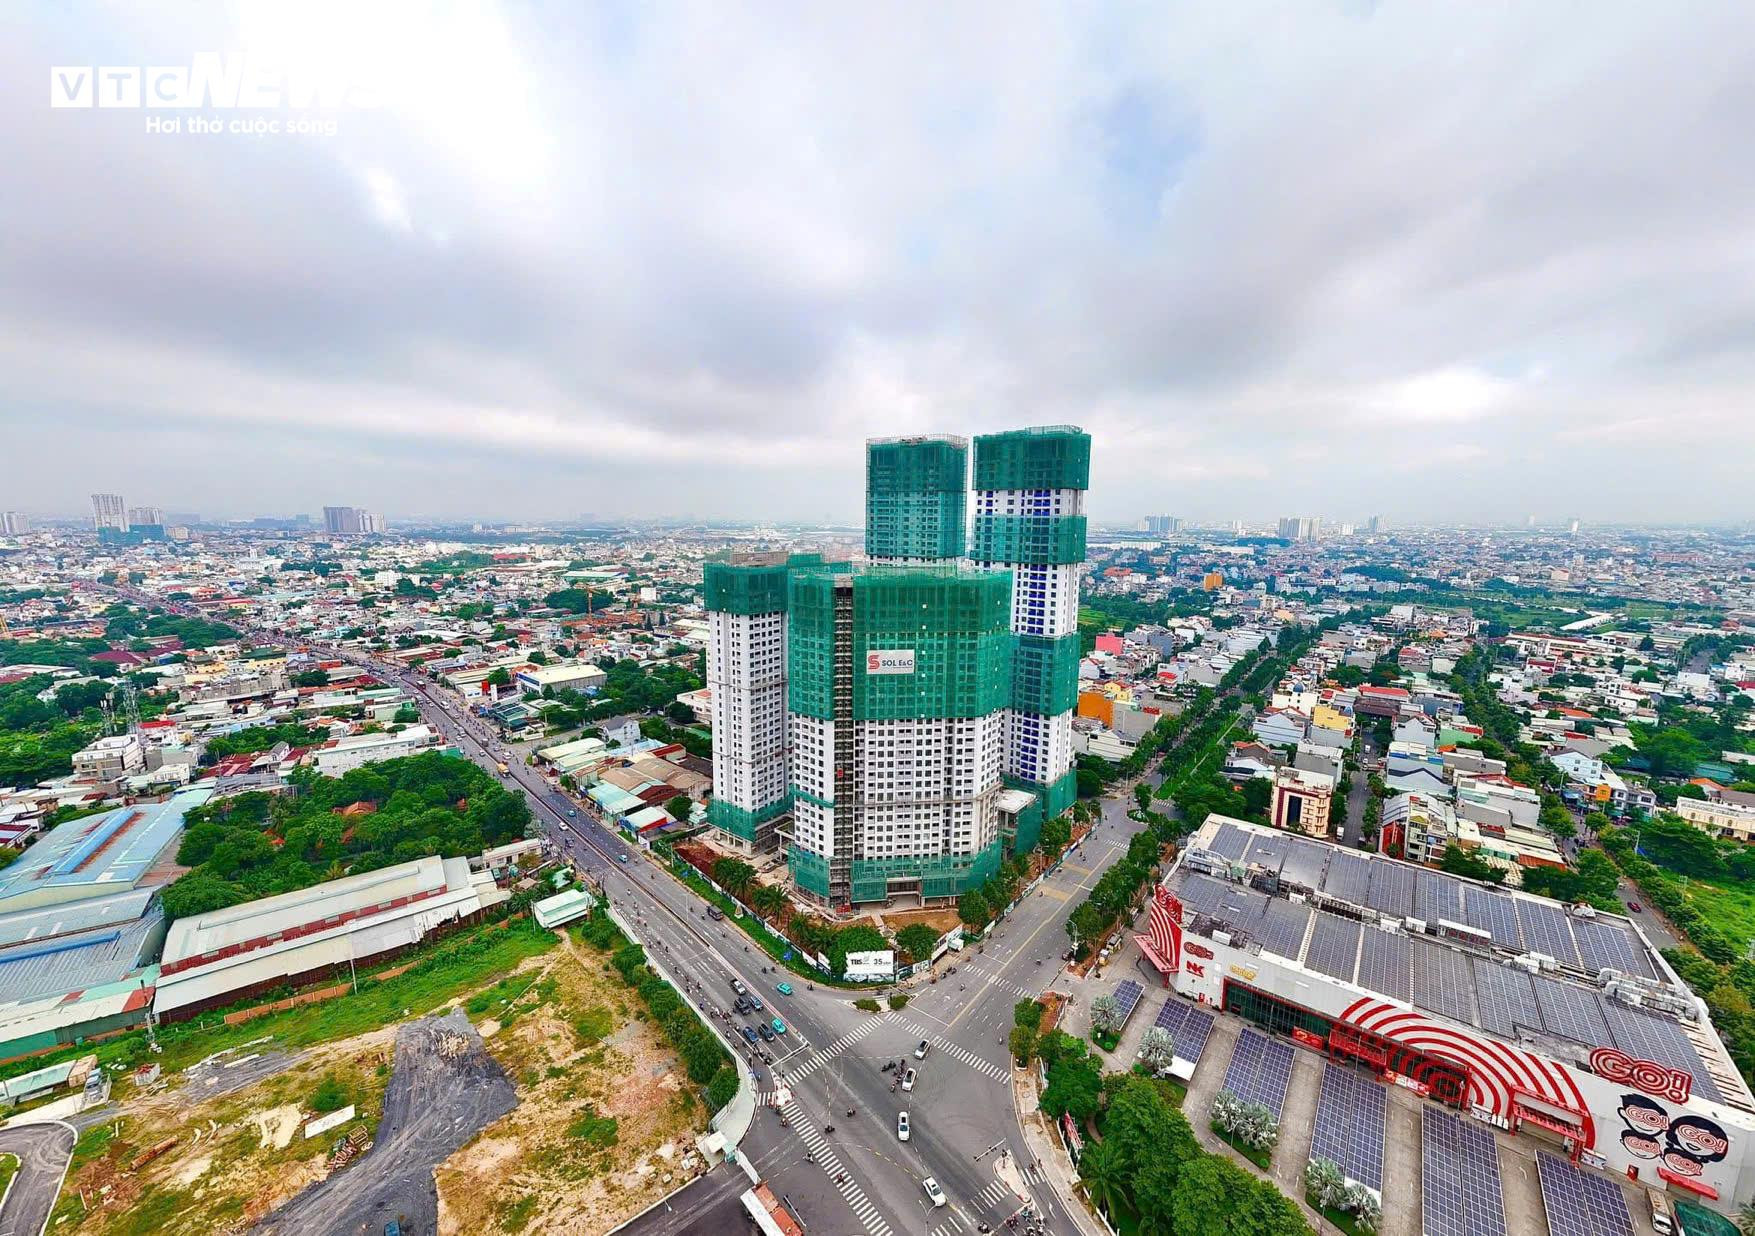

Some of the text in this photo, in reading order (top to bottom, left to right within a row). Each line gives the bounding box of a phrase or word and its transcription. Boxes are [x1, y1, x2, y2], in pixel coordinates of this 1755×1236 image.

[1186, 961, 1205, 977] NK
[1590, 1047, 1693, 1105] GO!
[1625, 1105, 1670, 1130] GO!
[1624, 1135, 1660, 1155] GO!
[1678, 1124, 1727, 1153] GO!
[1664, 1153, 1703, 1175] GO!
